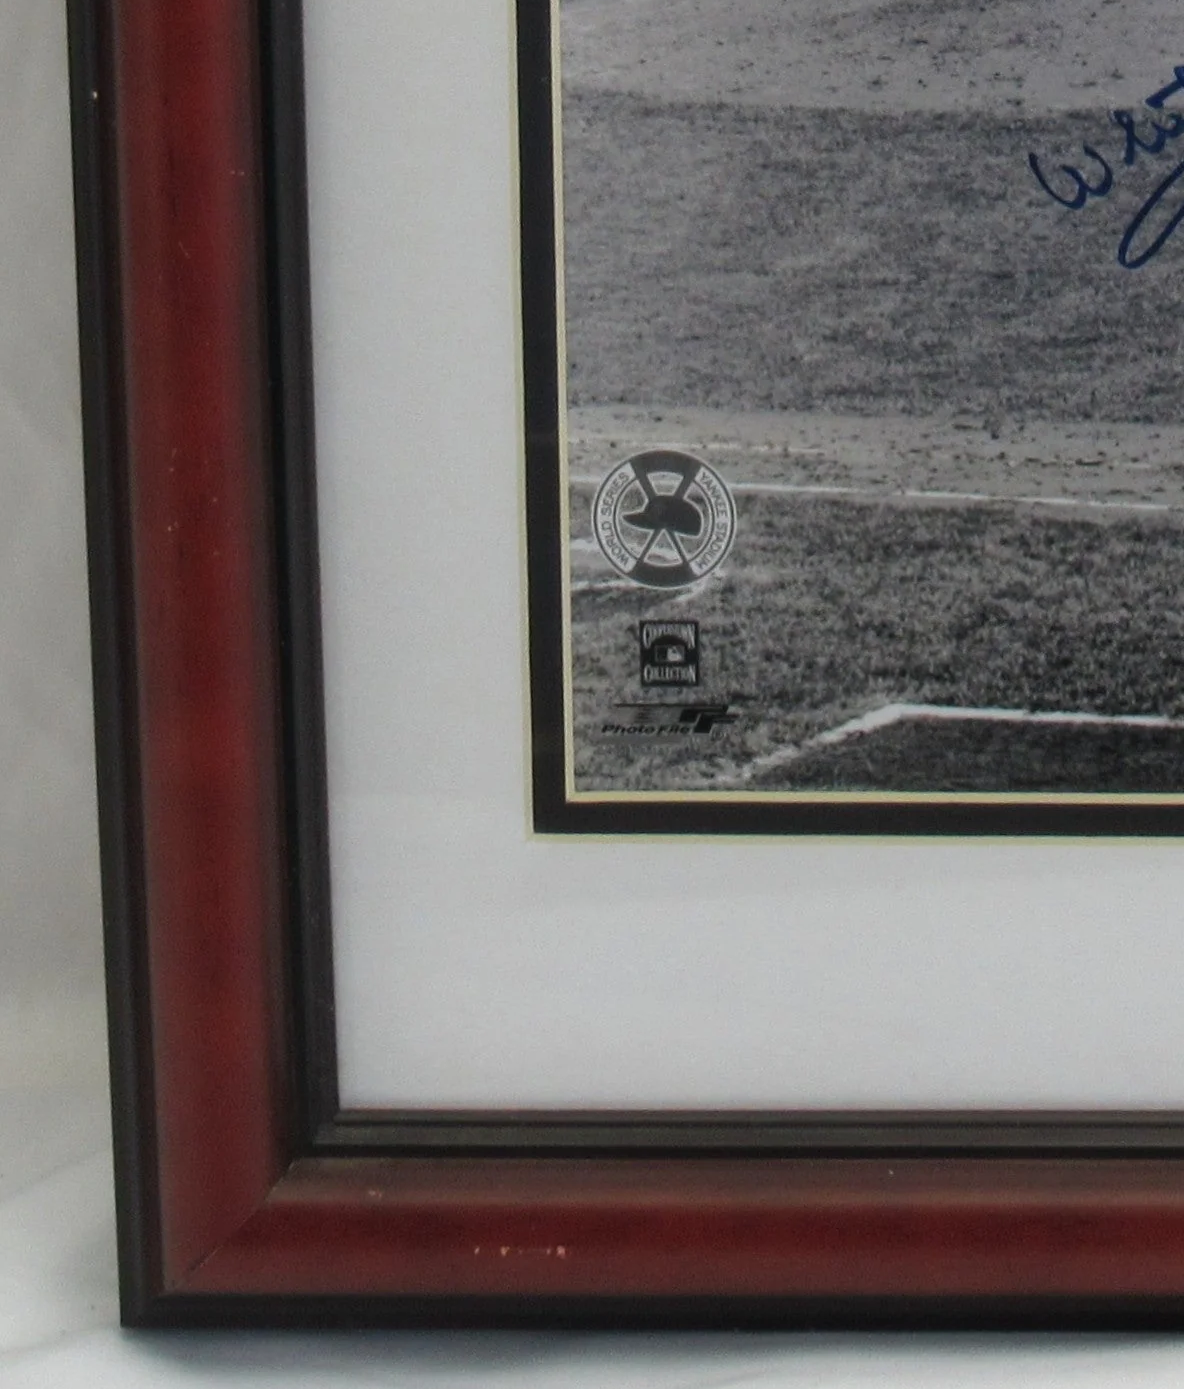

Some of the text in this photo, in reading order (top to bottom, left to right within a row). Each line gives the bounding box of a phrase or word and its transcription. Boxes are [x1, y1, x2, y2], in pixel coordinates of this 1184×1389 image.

[601, 471, 630, 567] WORLD SERIES
[698, 471, 727, 571] YANKEE STADIUM
